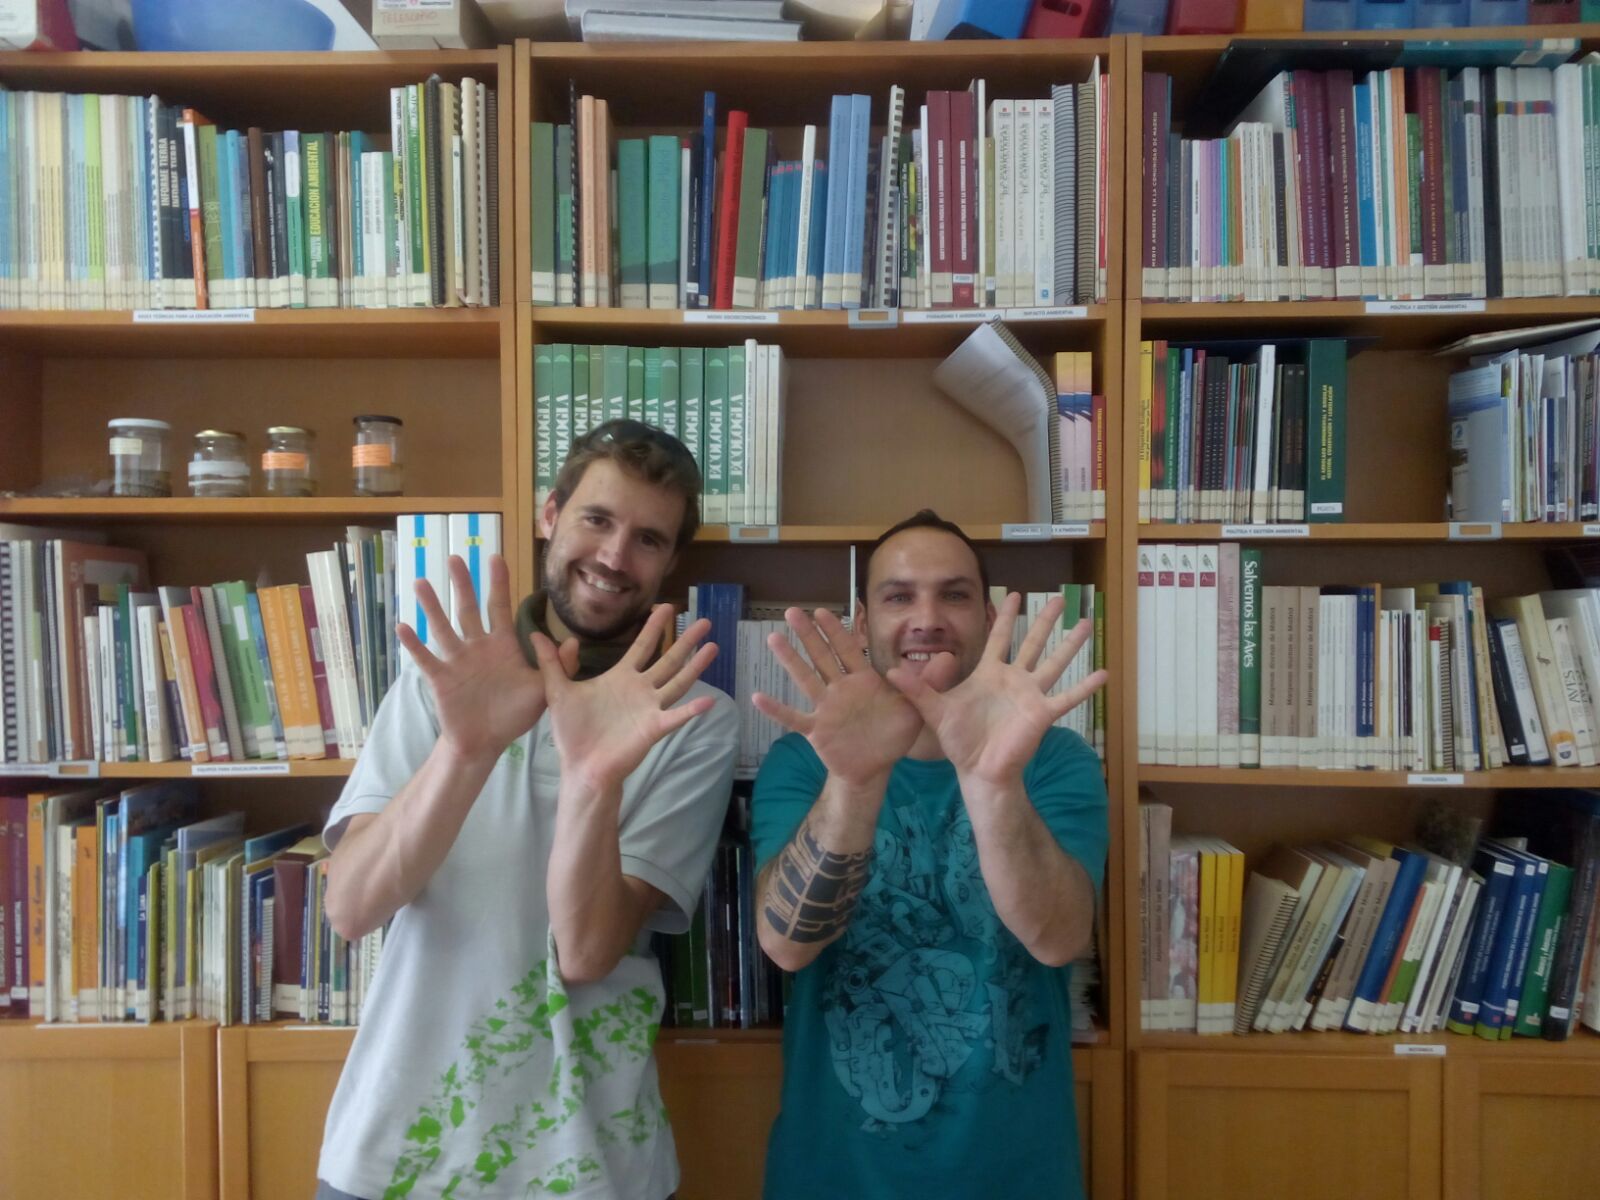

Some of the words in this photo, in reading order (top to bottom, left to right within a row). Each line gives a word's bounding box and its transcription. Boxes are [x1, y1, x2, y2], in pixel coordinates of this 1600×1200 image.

[158, 137, 168, 167] TIERRA
[307, 141, 319, 188] AMBIENTAL
[159, 168, 170, 206] INFORME
[1243, 560, 1258, 618] Salvemos
[1243, 620, 1257, 637] las
[1243, 639, 1257, 668] Aves
